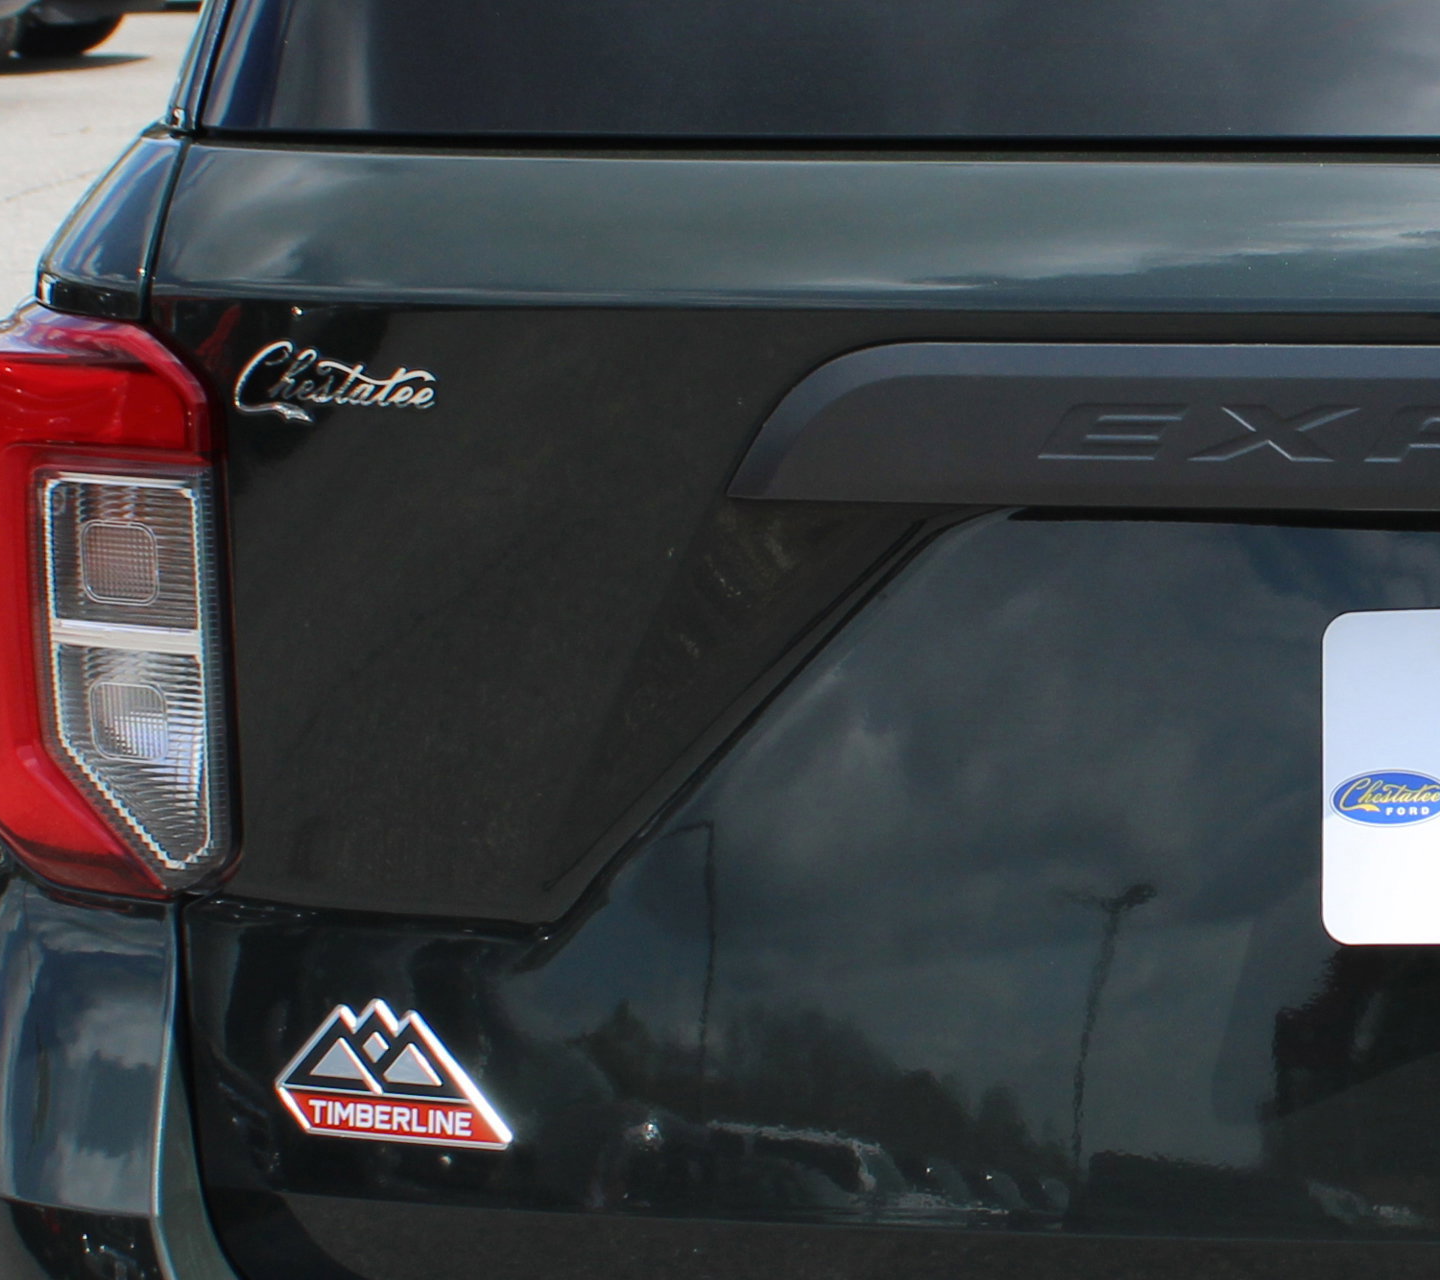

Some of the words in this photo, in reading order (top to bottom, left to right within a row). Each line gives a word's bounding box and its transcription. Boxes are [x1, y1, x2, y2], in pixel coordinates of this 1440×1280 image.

[234, 340, 437, 422] Chestatee
[1385, 806, 1430, 816] FORD
[308, 1099, 473, 1137] TIMBERLINE
